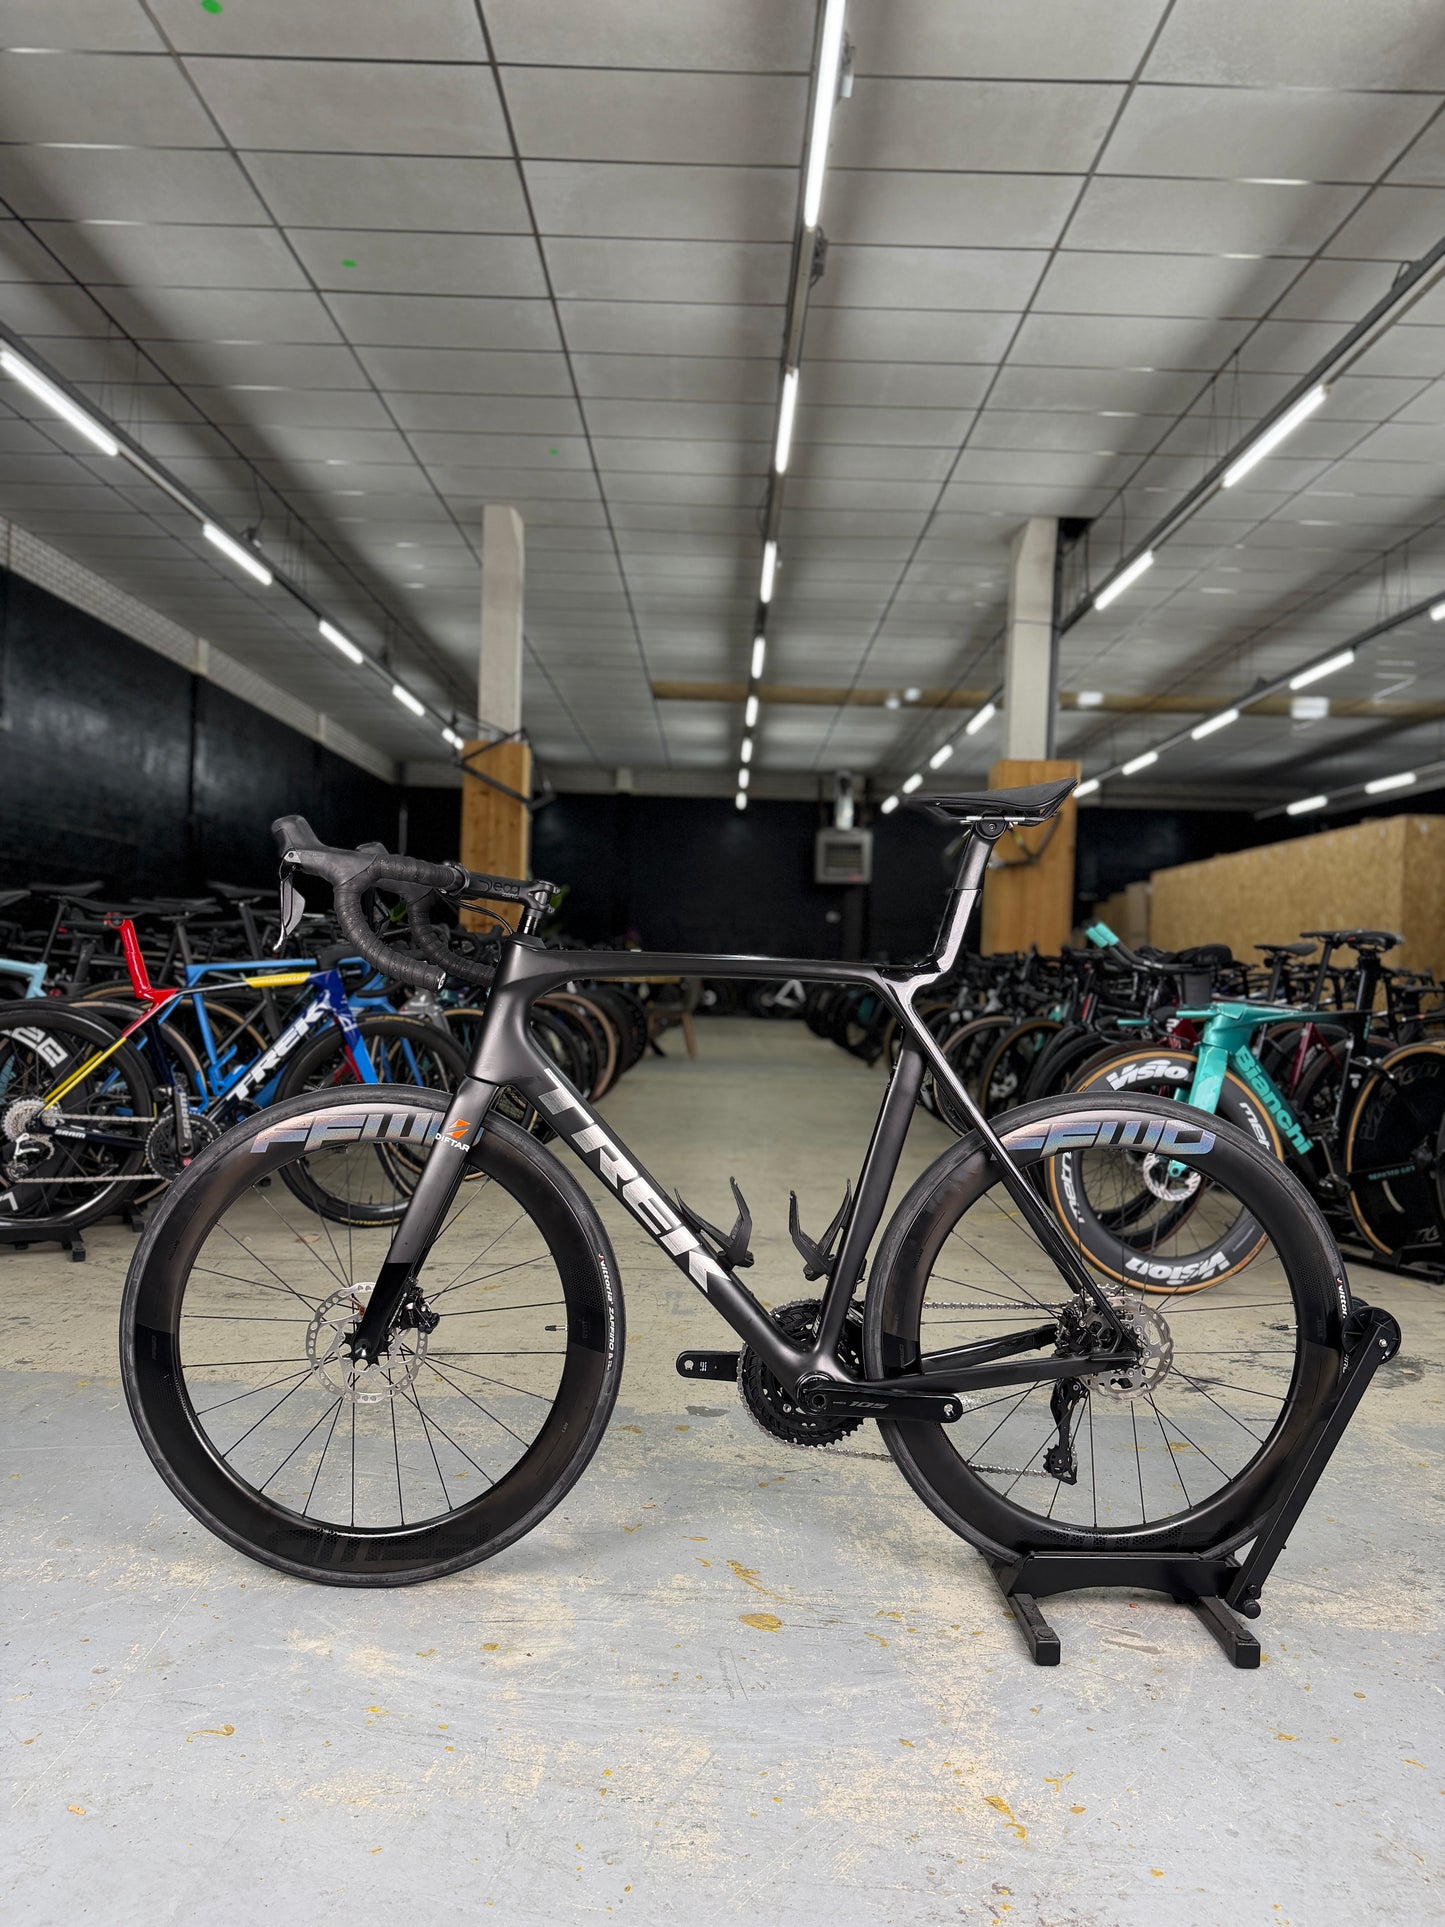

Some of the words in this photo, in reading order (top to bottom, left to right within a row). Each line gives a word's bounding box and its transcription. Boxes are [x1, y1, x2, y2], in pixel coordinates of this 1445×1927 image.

[226, 1001, 324, 1101] TREK
[1235, 1045, 1314, 1155] Bianchi
[54, 1128, 87, 1139] SRAM
[435, 1132, 470, 1153] DIFTAR
[992, 1119, 1216, 1158] FFWD
[1239, 1102, 1271, 1150] met
[538, 1068, 732, 1293] TREK
[1125, 1250, 1231, 1286] Vision
